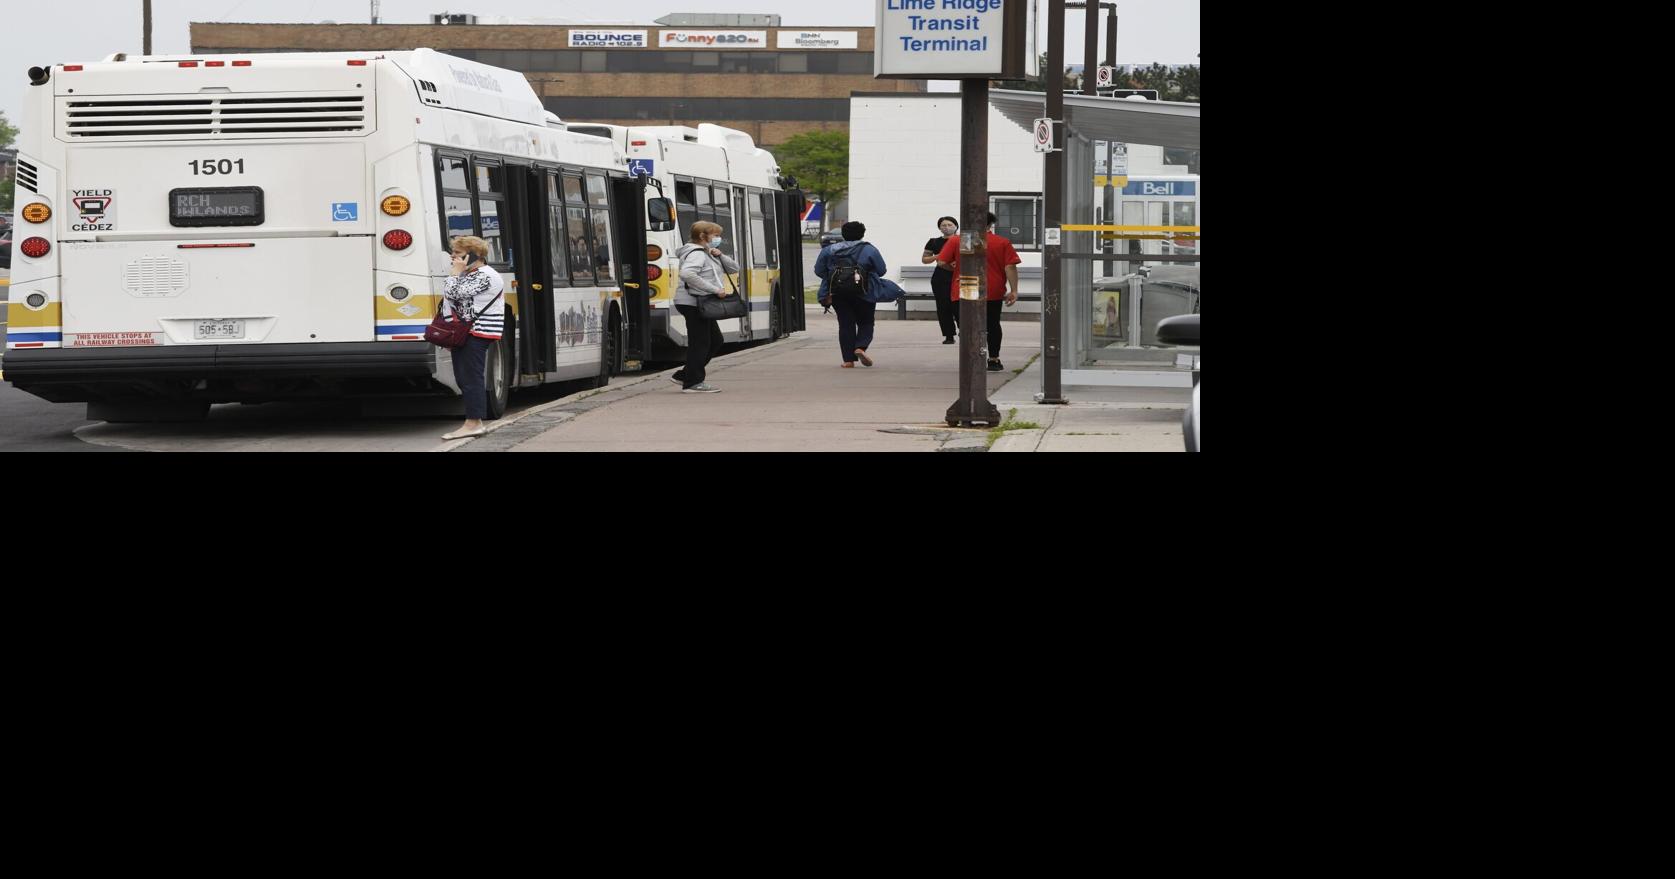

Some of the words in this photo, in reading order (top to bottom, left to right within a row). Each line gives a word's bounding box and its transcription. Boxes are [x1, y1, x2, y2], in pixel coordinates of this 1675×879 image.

[887, 0, 935, 10] Lime
[942, 0, 1001, 13] Ridge
[908, 15, 980, 30] Transit
[572, 33, 643, 41] BOUNCE
[900, 36, 988, 51] Terminal
[188, 158, 245, 176] 1501
[72, 189, 113, 197] YIELD
[1143, 181, 1175, 195] Bell
[71, 223, 113, 232] CÉDEZ
